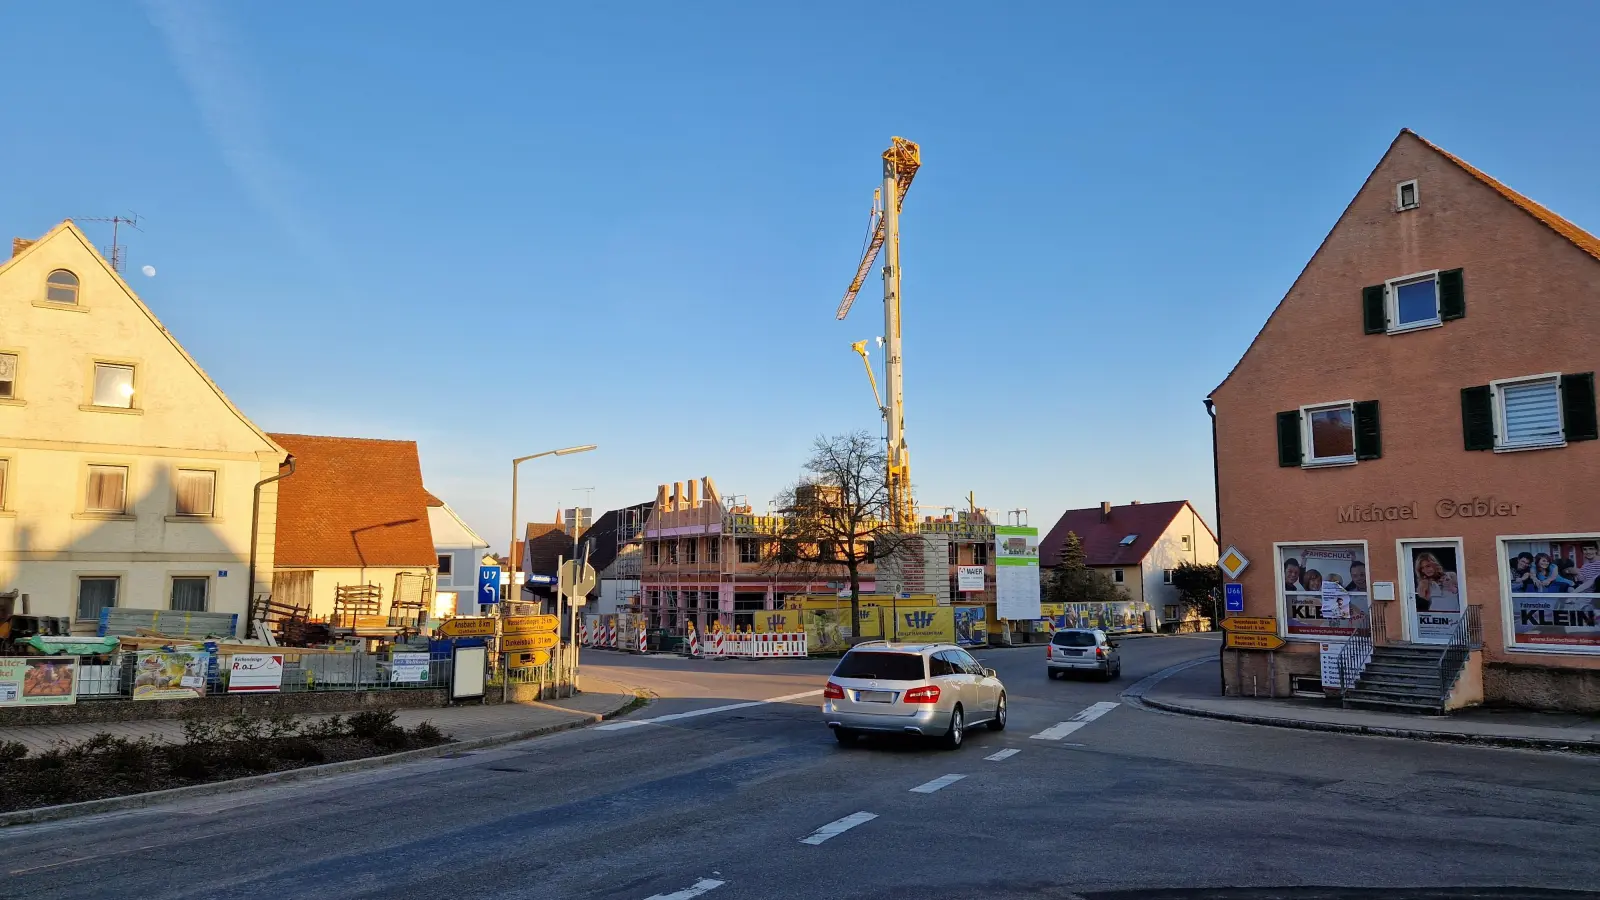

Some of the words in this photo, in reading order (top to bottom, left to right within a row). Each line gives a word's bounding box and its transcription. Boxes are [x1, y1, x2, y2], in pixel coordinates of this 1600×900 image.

[1337, 500, 1419, 524] Michael
[1435, 495, 1521, 519] Gabler
[1306, 551, 1351, 559] FAHRSCHULE
[483, 571, 490, 580] U
[491, 571, 497, 580] 7
[1291, 605, 1323, 619] KLE
[1520, 609, 1596, 627] KLEIN
[454, 620, 476, 628] Ansbach
[506, 638, 536, 646] Dinkelsbühl
